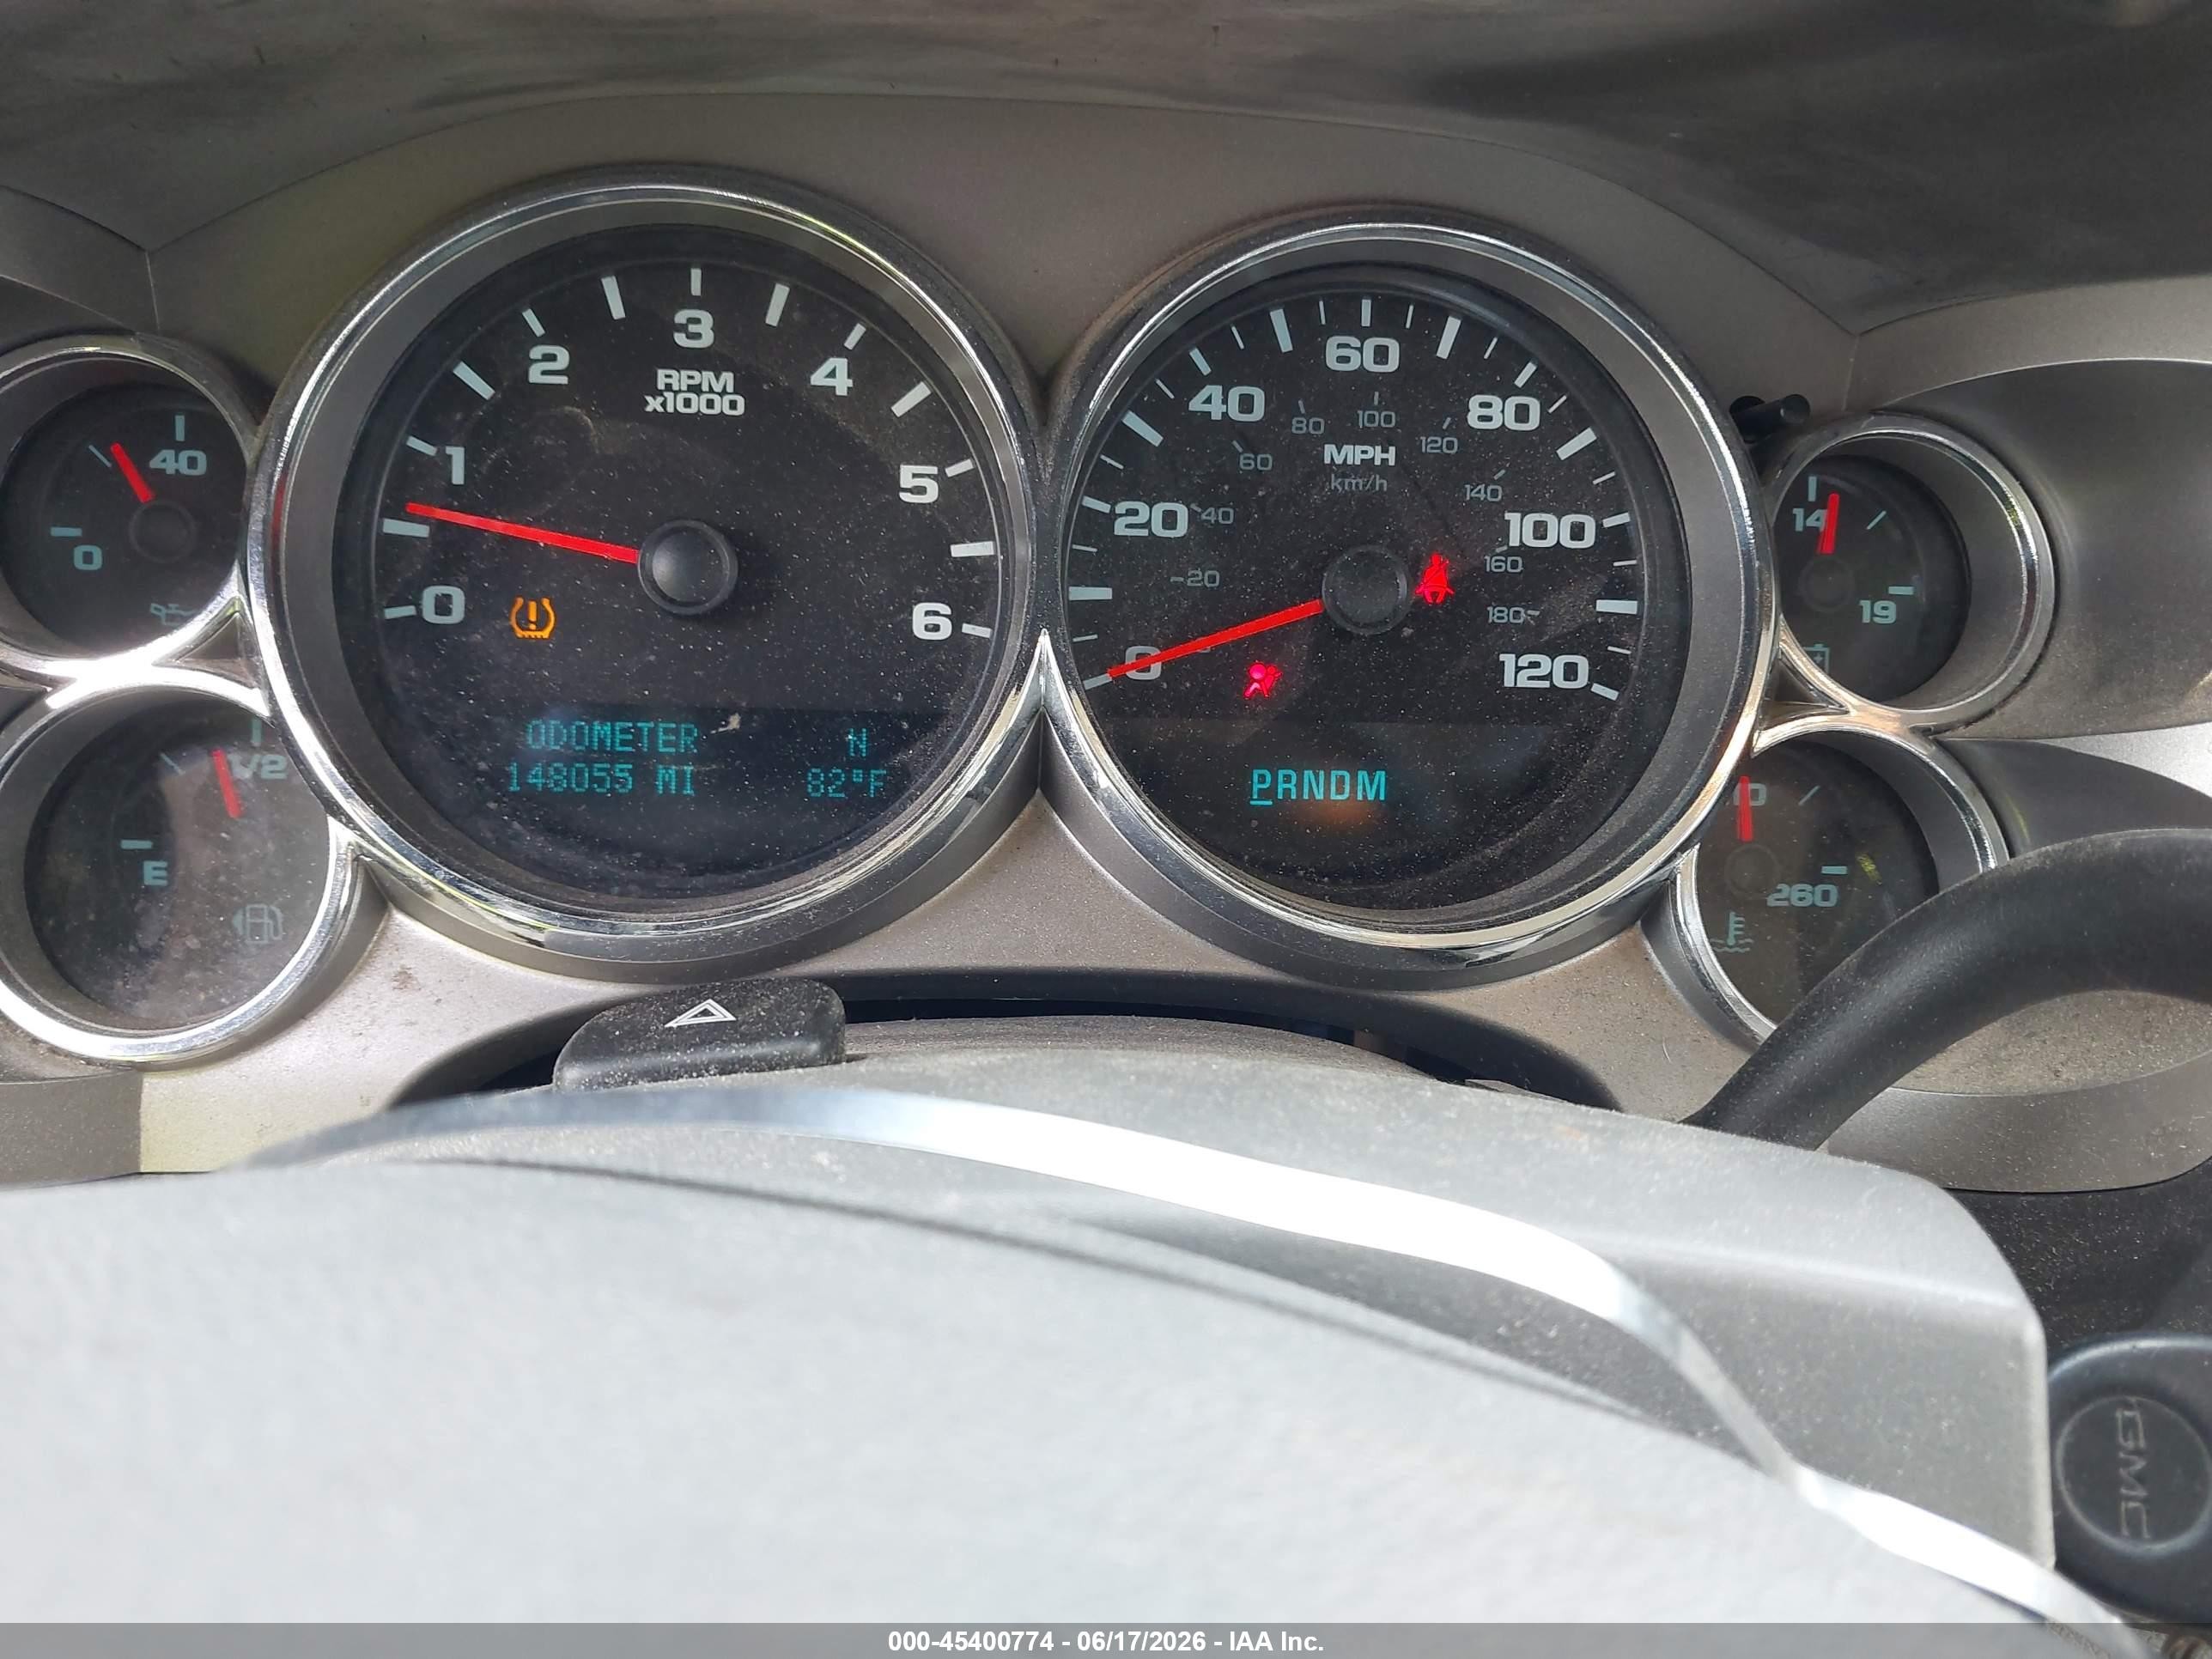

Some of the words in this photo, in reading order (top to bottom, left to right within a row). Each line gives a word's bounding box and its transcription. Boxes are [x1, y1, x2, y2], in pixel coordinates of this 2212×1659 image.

[673, 309, 714, 349] 3
[527, 344, 570, 385] 2
[1325, 336, 1401, 373] 60
[656, 369, 734, 393] RPM
[810, 357, 854, 396] 4
[644, 394, 745, 416] x1000
[1188, 385, 1265, 422] 40
[1467, 395, 1540, 431] 80
[1291, 417, 1325, 434] 80
[1358, 410, 1396, 428] 100
[1323, 444, 1396, 466] MPH
[1419, 436, 1458, 454] 120
[149, 450, 207, 476] 40
[445, 447, 465, 485] 1
[1239, 454, 1273, 471] 60
[898, 465, 939, 504] 5
[1330, 474, 1388, 492] km/h
[1464, 484, 1502, 502] 140
[1114, 501, 1188, 538] 20
[1202, 507, 1234, 525] 40
[1504, 512, 1595, 549] 100
[73, 544, 102, 570] 0
[1485, 556, 1522, 574] 160
[1187, 570, 1220, 587] 20
[422, 586, 465, 625] 0
[1487, 606, 1524, 624] 180
[1859, 599, 1897, 624] 19
[912, 602, 952, 641] 6
[1125, 645, 1162, 681] 0
[1499, 653, 1589, 689] 120
[526, 720, 698, 753] ODOMETER
[849, 728, 867, 757] N
[508, 762, 634, 793] 148055
[655, 763, 696, 797] MI
[1251, 769, 1388, 805] PRNDM
[143, 860, 169, 887] E
[1766, 884, 1839, 907] 260
[2116, 1407, 2150, 1539] GMC
